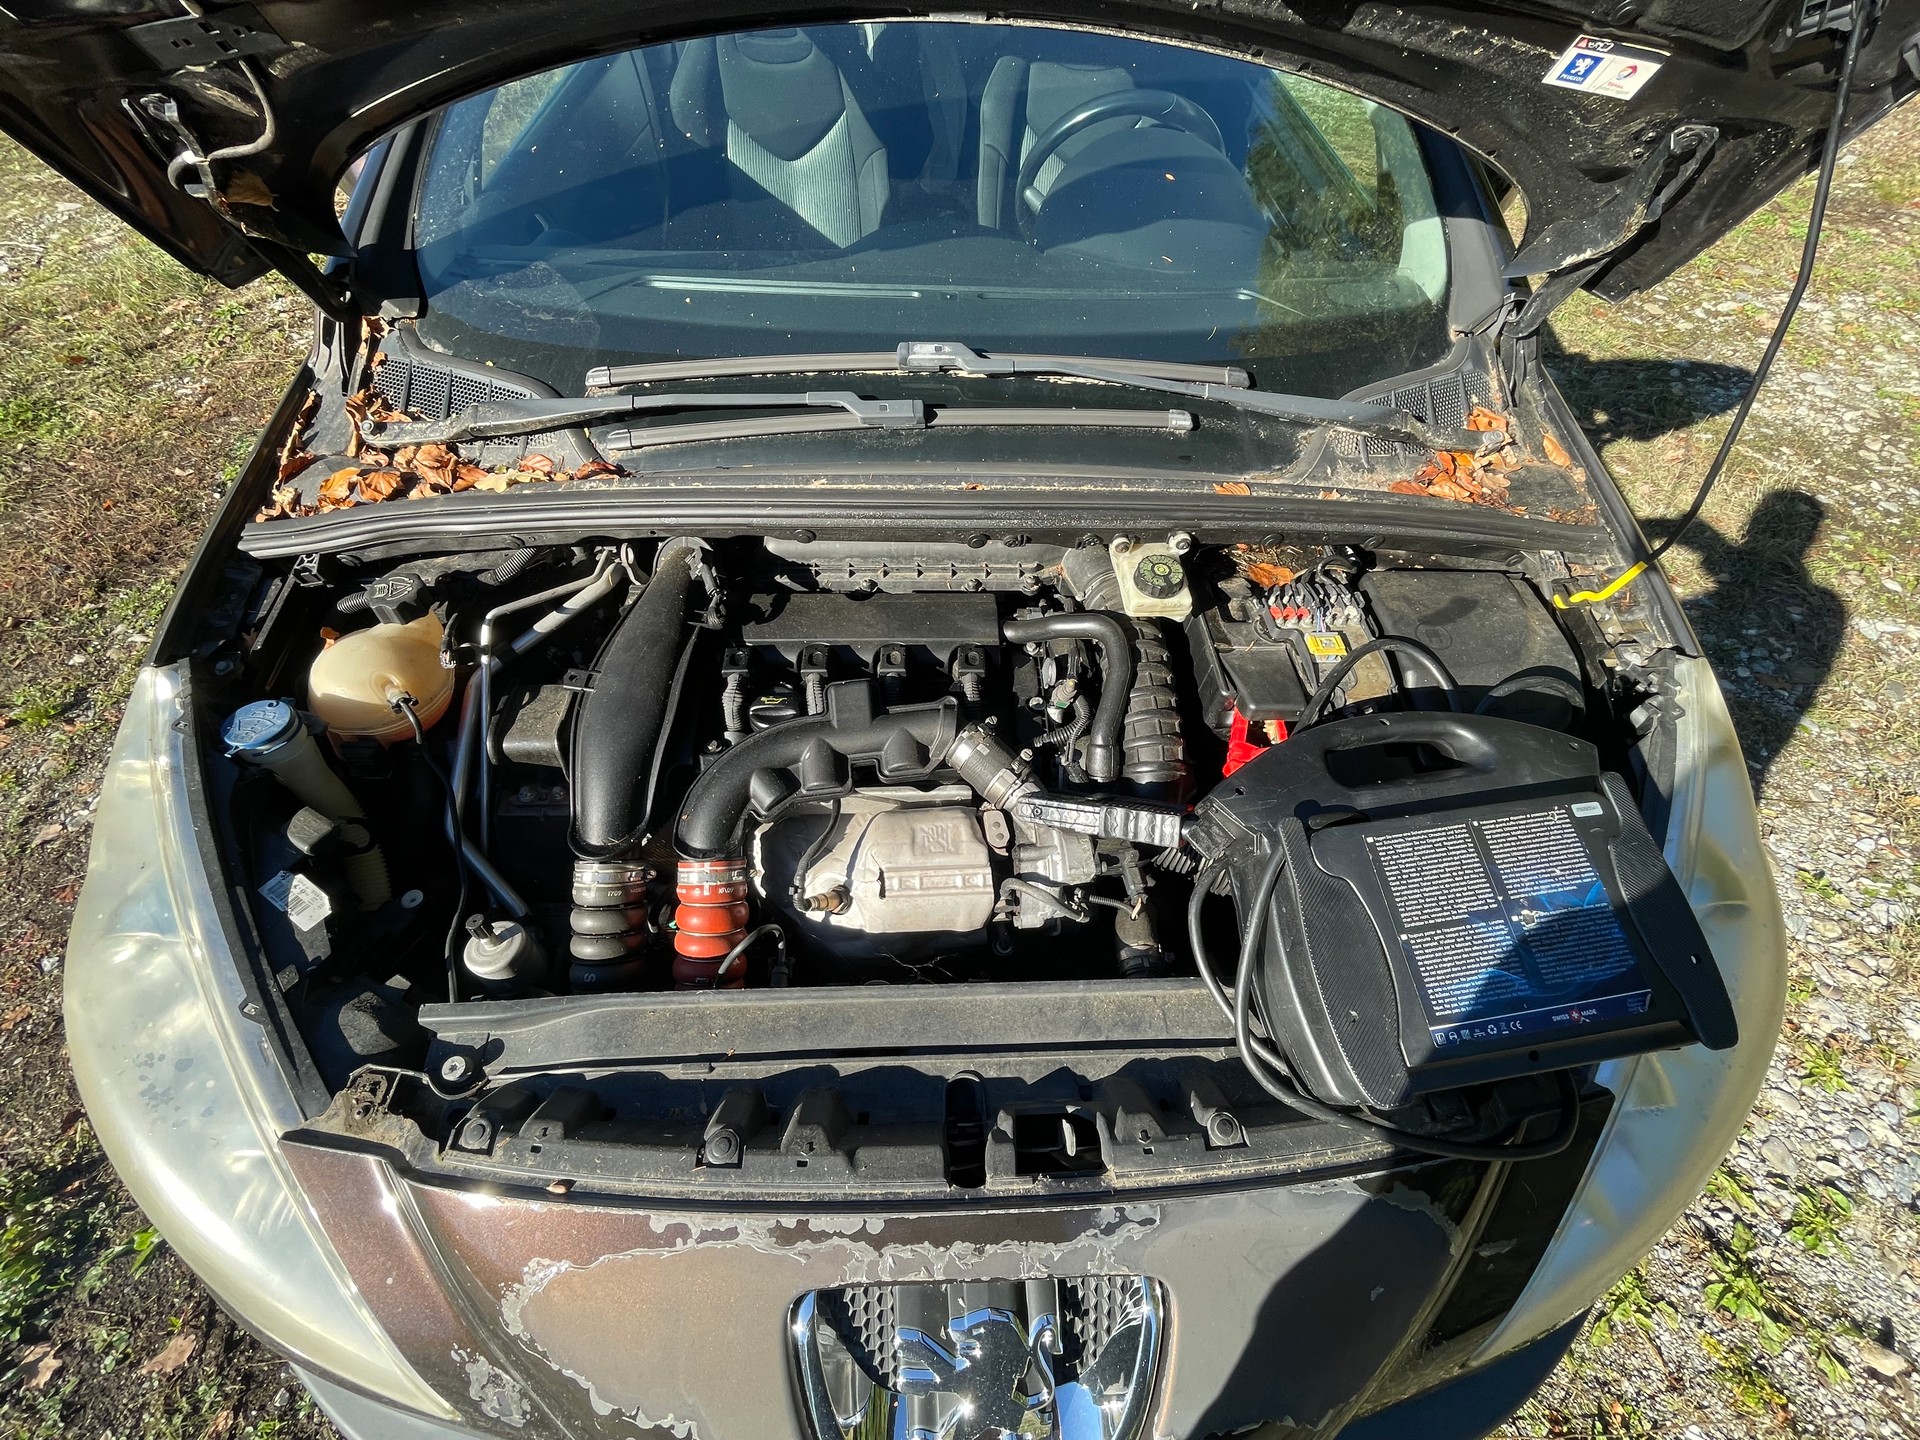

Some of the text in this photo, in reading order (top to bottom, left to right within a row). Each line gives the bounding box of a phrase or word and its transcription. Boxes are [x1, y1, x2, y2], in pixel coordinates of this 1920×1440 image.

[1559, 74, 1584, 82] PEUGEOT
[1552, 1008, 1598, 1022] SWISS MADE
